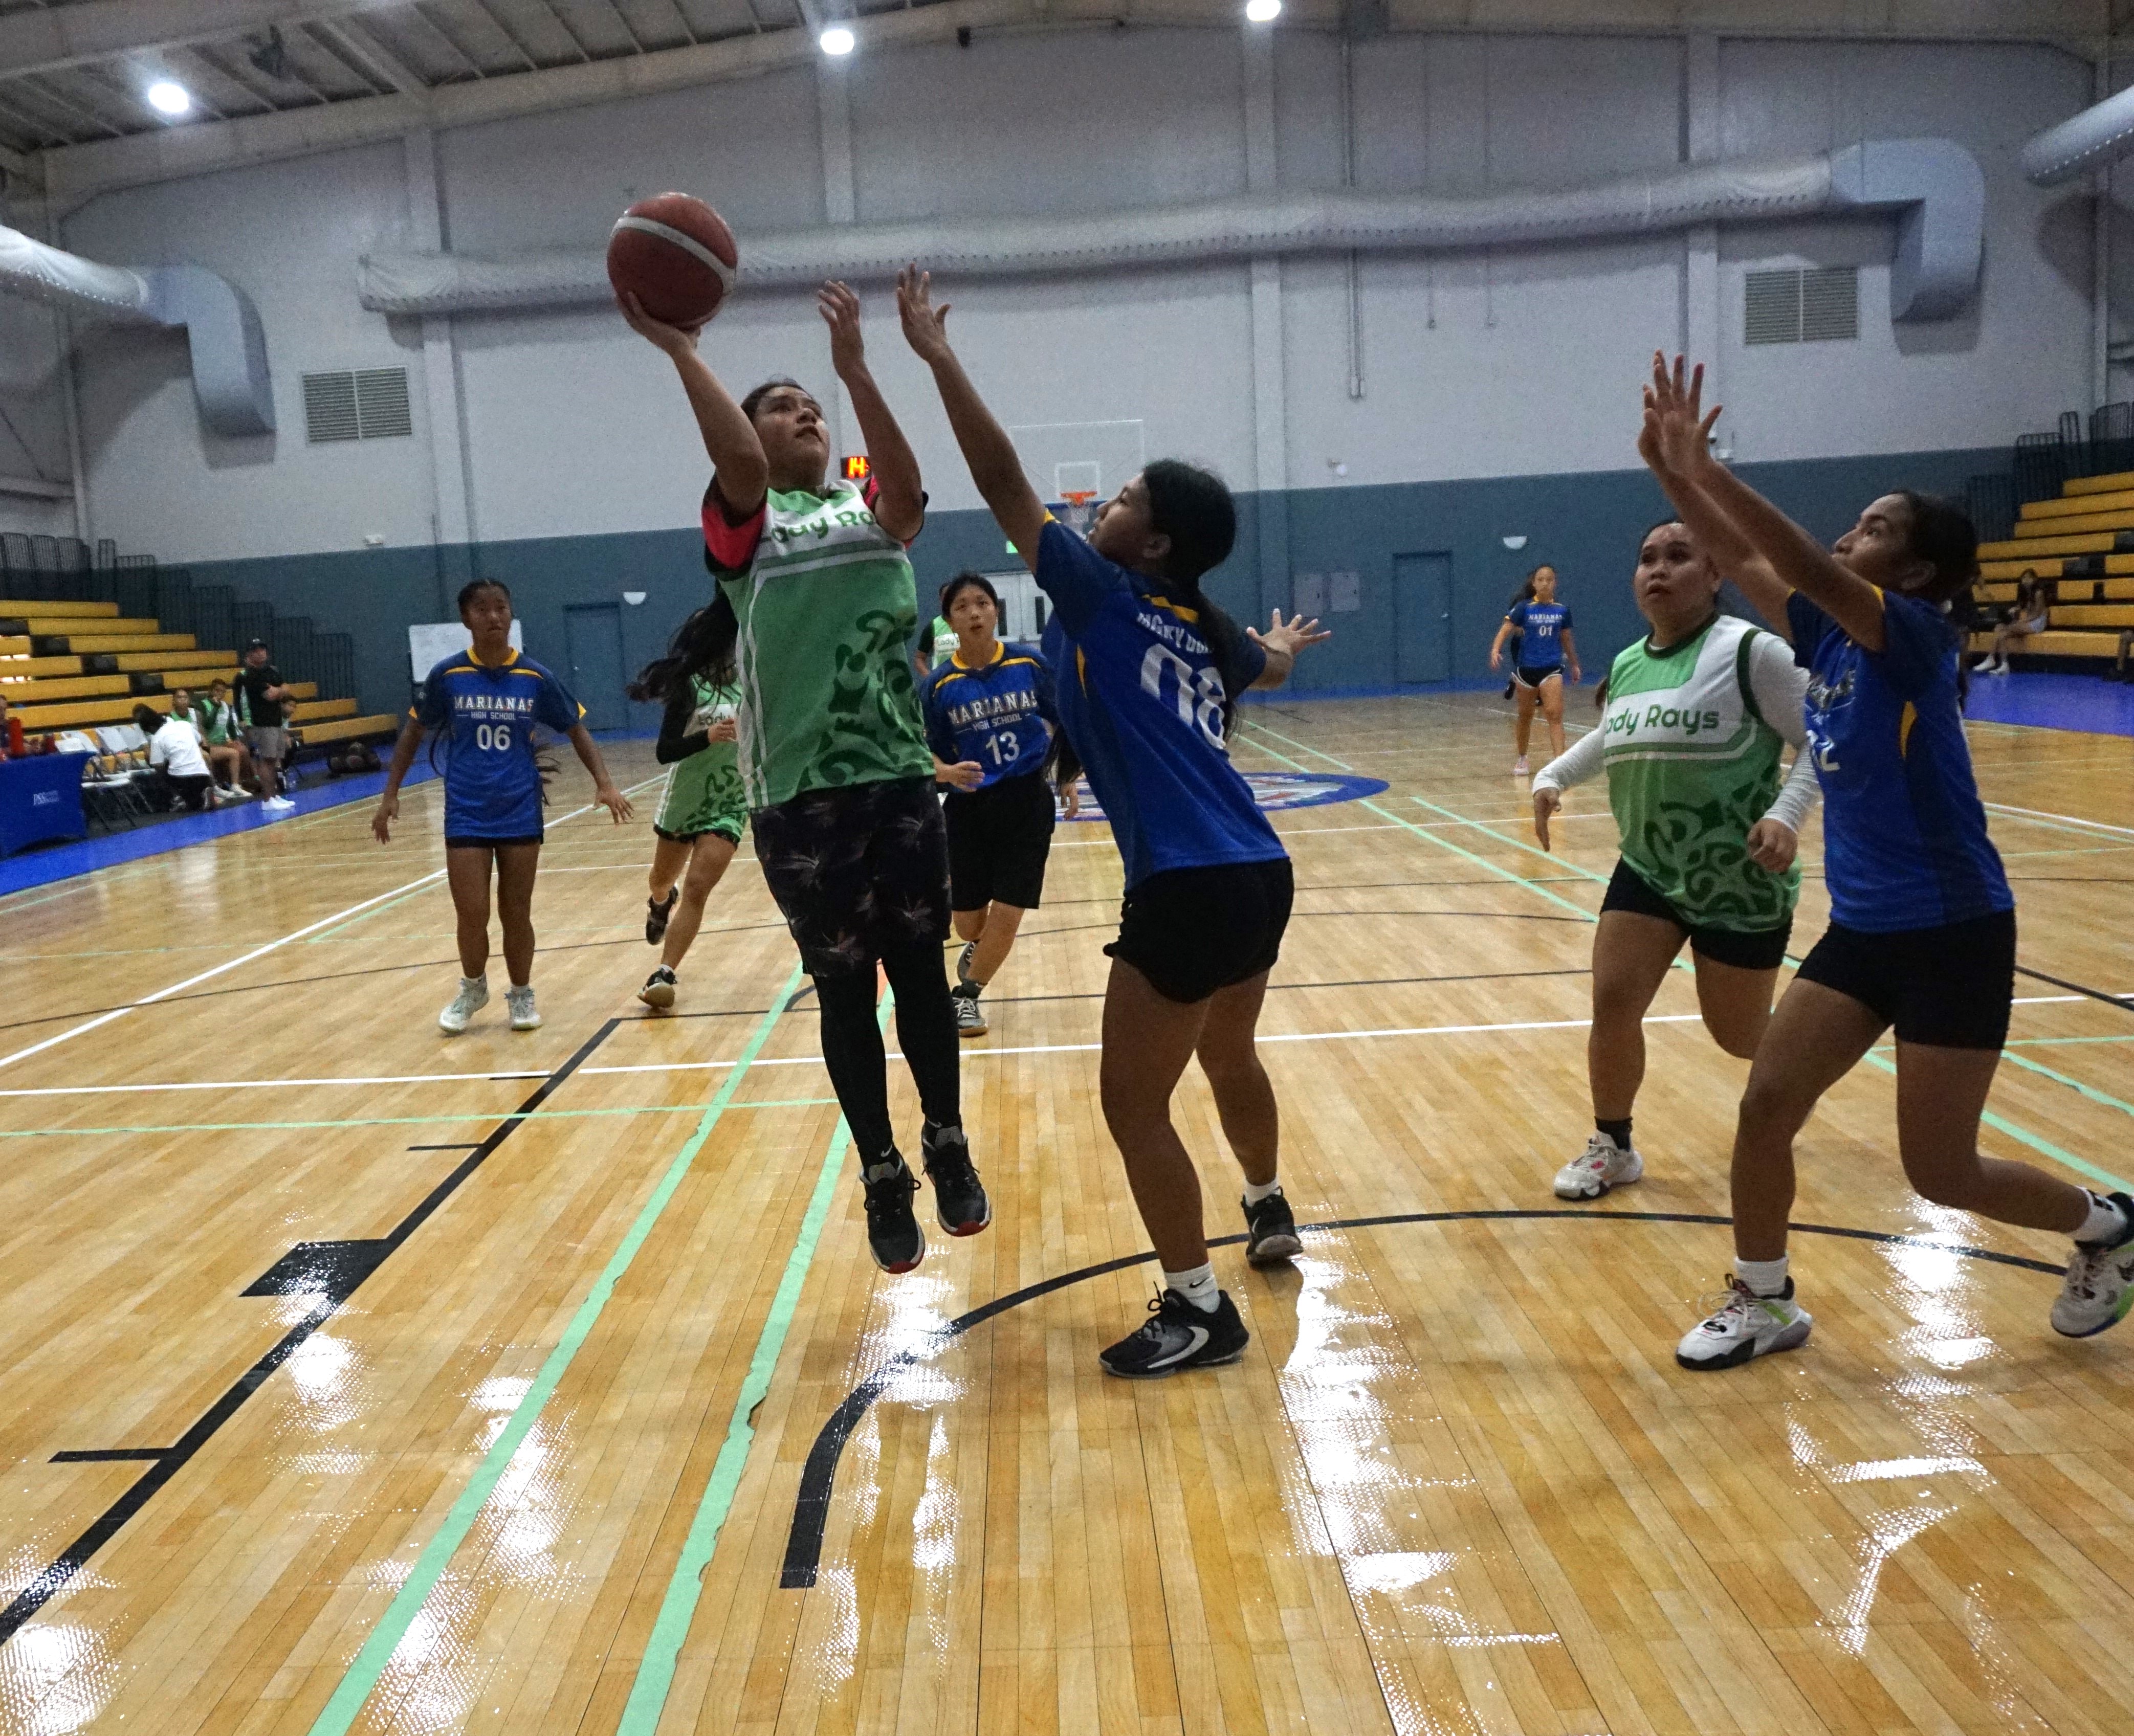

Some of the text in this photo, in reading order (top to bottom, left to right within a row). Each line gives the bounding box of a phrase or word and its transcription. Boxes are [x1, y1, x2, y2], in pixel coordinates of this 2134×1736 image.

[1539, 626, 1552, 636] 01
[454, 695, 534, 712] MARIANAS
[490, 711, 516, 720] SCHOOL
[992, 713, 1023, 727] SCHOOL
[1645, 703, 1720, 735] Rays
[477, 724, 511, 750] 06
[985, 731, 1020, 765] 13
